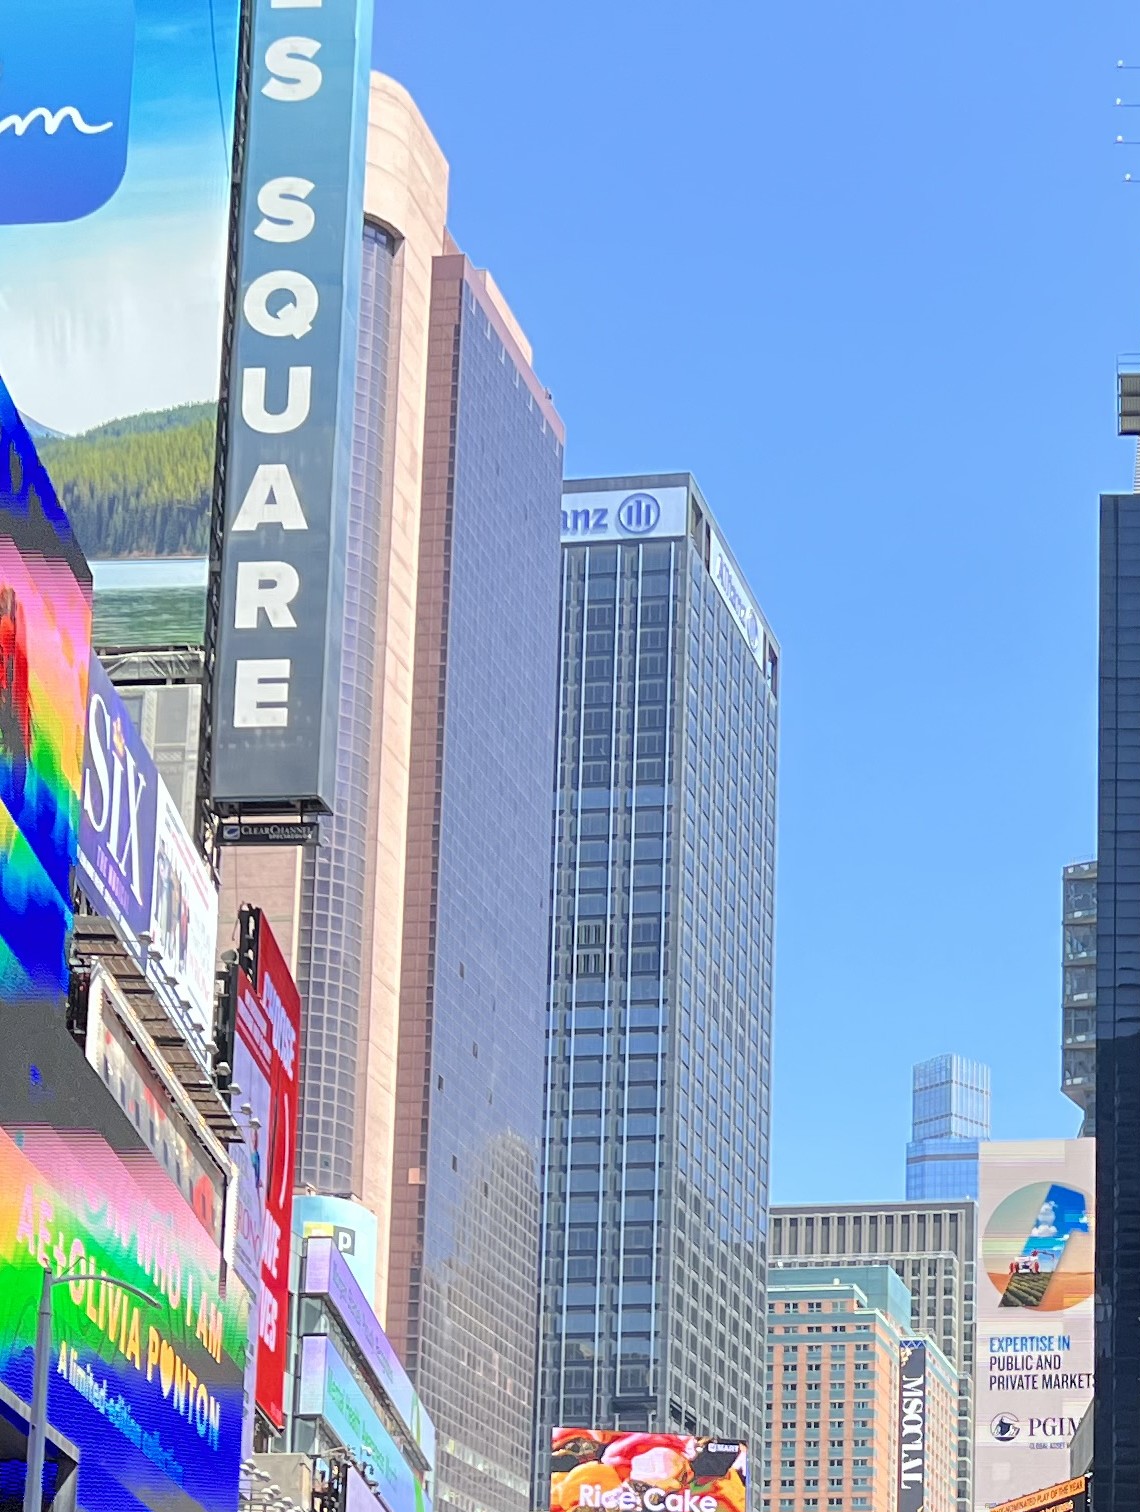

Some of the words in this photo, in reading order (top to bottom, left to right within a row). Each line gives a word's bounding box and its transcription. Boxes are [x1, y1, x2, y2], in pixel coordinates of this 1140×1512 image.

[231, 176, 320, 729] SQUARE
[84, 693, 147, 906] SIX
[68, 1239, 141, 1371] OLIVIA
[195, 1292, 223, 1364] AM
[989, 1336, 1055, 1353] EXPERTISE
[1058, 1335, 1071, 1351] IN
[989, 1355, 1034, 1371] PUBLIC
[1036, 1354, 1062, 1370] AND
[989, 1374, 1039, 1391] PRIVATE
[578, 1484, 636, 1511] Rice
